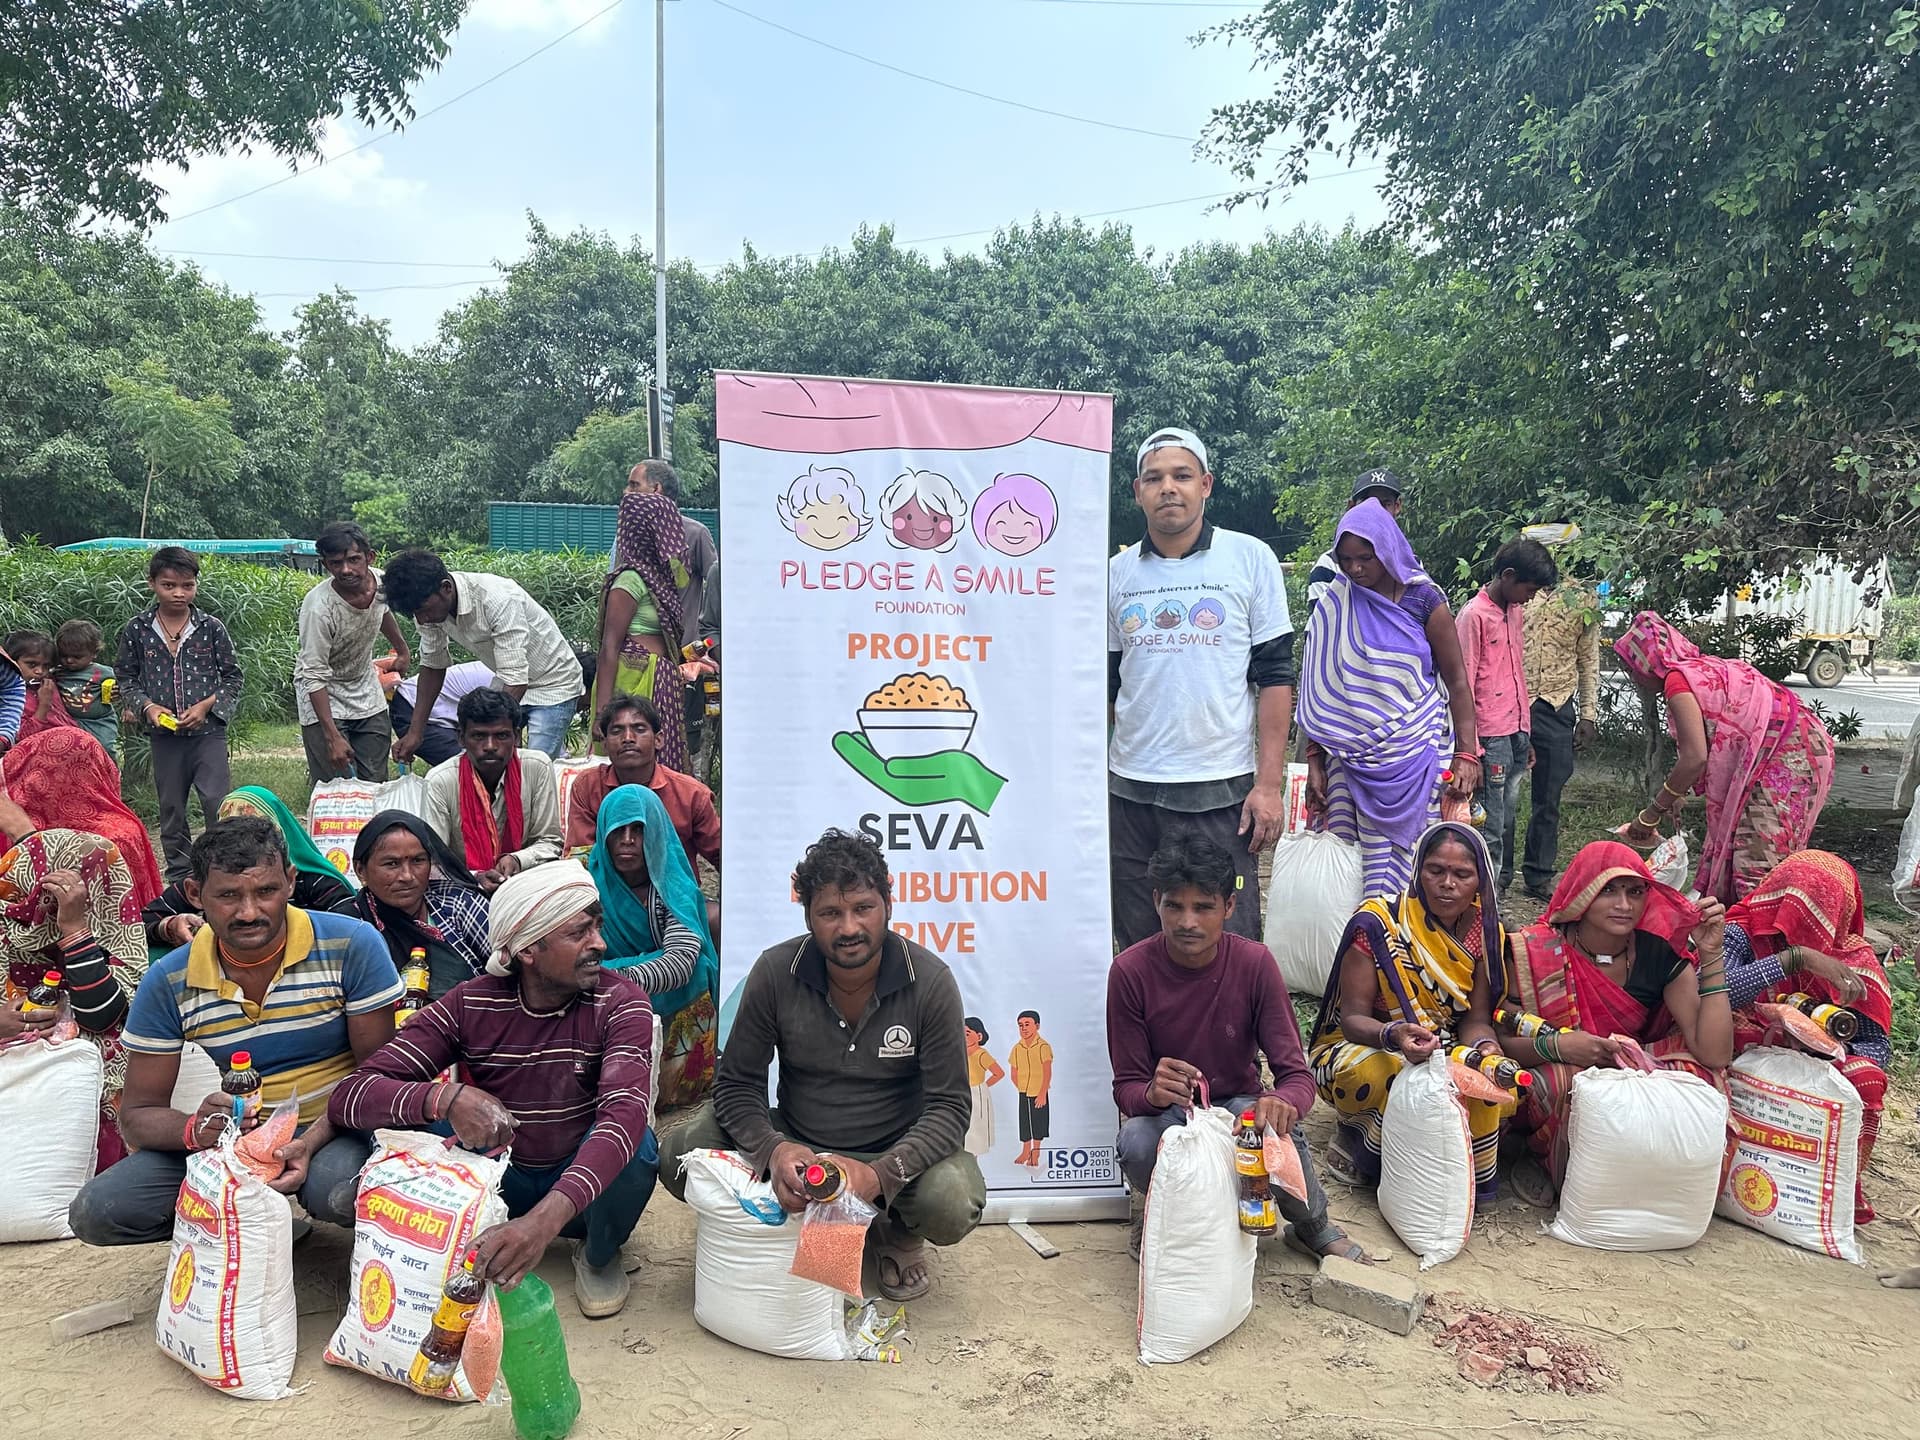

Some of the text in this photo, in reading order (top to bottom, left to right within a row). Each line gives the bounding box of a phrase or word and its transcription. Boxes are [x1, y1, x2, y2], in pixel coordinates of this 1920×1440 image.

[780, 559, 1056, 596] PLEDGE A SMILE
[1158, 585, 1192, 594] deserves
[875, 601, 966, 616] FOUNDATION
[1166, 633, 1175, 645] A
[1180, 633, 1222, 646] SMILE
[847, 633, 993, 667] PROJECT
[859, 813, 984, 850] SEVA
[790, 871, 1047, 902] IBUTION
[892, 922, 975, 953] RIVE
[1048, 1150, 1109, 1169] ISO 9001
[1090, 1159, 1110, 1167] 2015
[1778, 1161, 1808, 1174] आटा
[1047, 1169, 1111, 1179] CERTIFIED
[366, 1193, 448, 1239] कृष्णा भोग
[400, 1254, 429, 1272] आटा
[223, 1287, 236, 1375] कृष्णा भोग आटा
